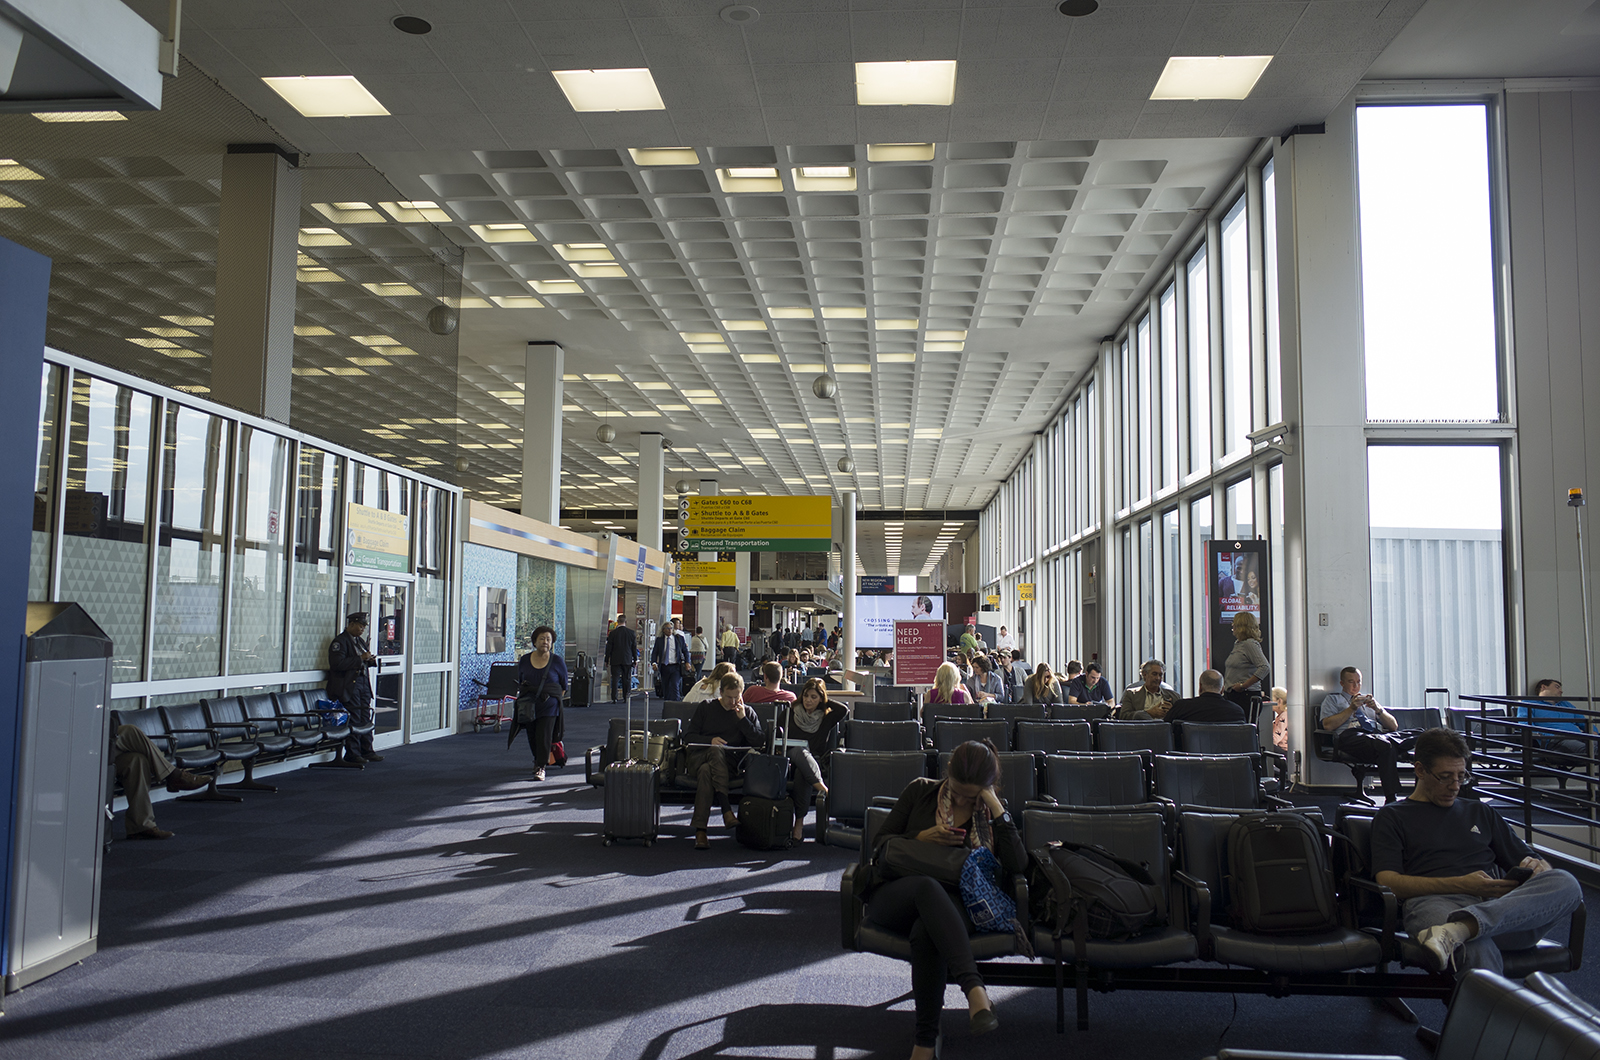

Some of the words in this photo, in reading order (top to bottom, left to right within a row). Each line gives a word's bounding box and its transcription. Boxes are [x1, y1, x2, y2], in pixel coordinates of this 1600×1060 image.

[357, 507, 370, 517] Shuttle
[387, 514, 397, 523] Gates
[363, 537, 378, 546] Baggage
[362, 555, 376, 564] Ground
[377, 558, 402, 568] Transportation
